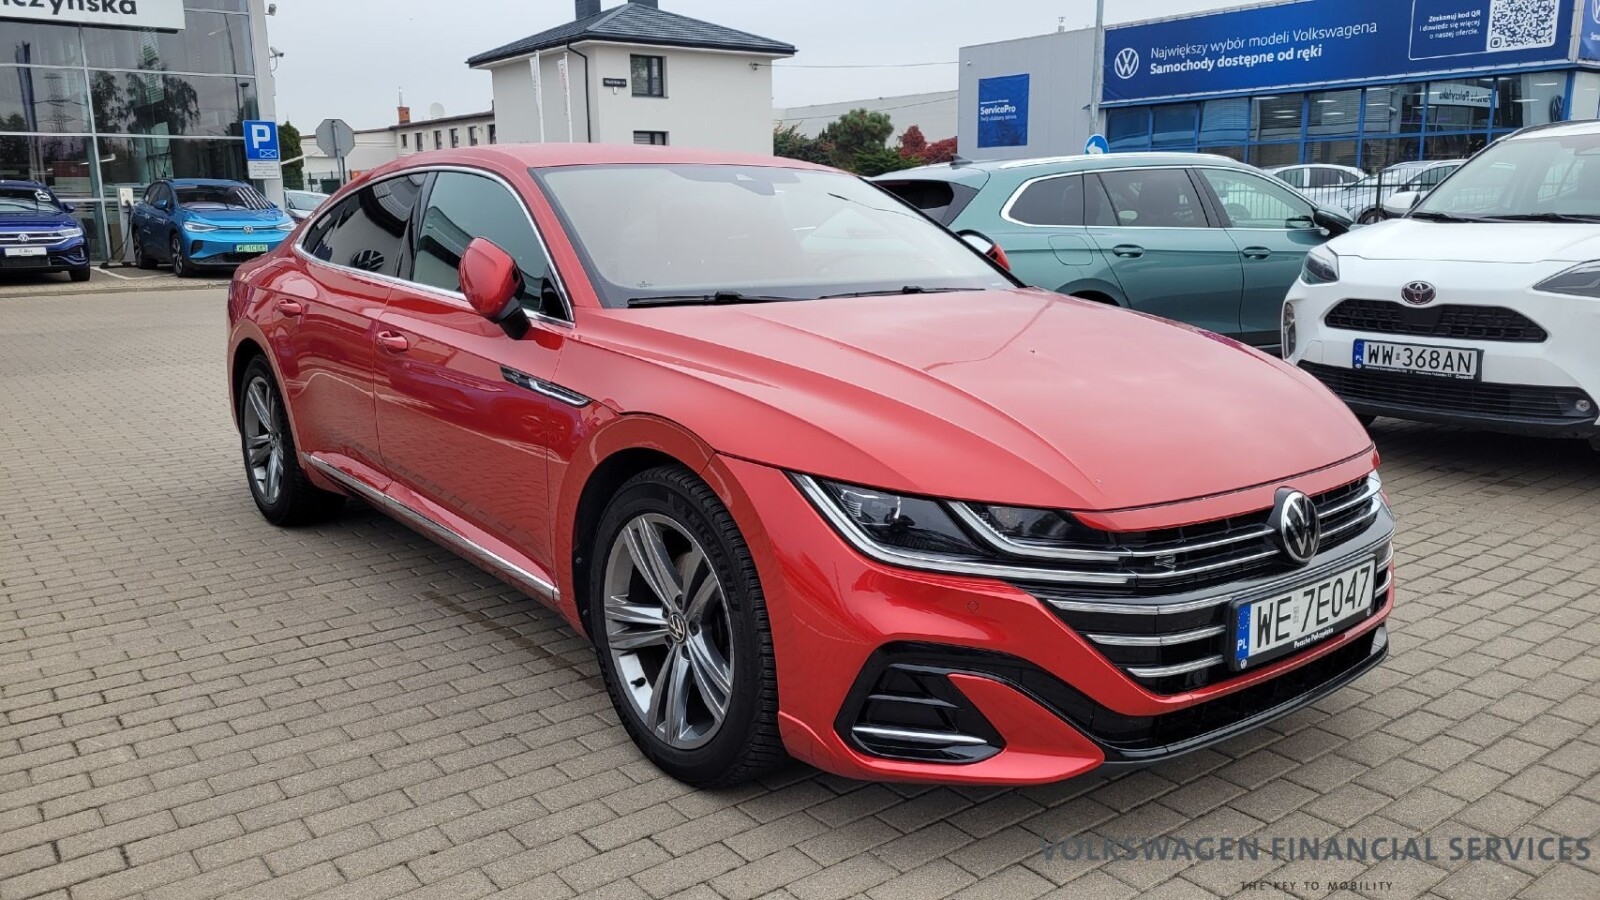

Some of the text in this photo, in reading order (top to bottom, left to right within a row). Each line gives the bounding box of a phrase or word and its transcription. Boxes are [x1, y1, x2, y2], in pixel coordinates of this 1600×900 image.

[1457, 11, 1470, 19] kod
[1471, 9, 1481, 18] QR
[1150, 22, 1378, 60] Największy wybór modeli Volkswagena
[1150, 43, 1322, 75] Samochody dostępne od ręki
[980, 104, 1016, 115] ServicePro
[251, 124, 271, 149] P
[1368, 344, 1394, 366] WW
[1402, 347, 1472, 373] 368AN
[1237, 565, 1371, 652] PL WE 7E047
